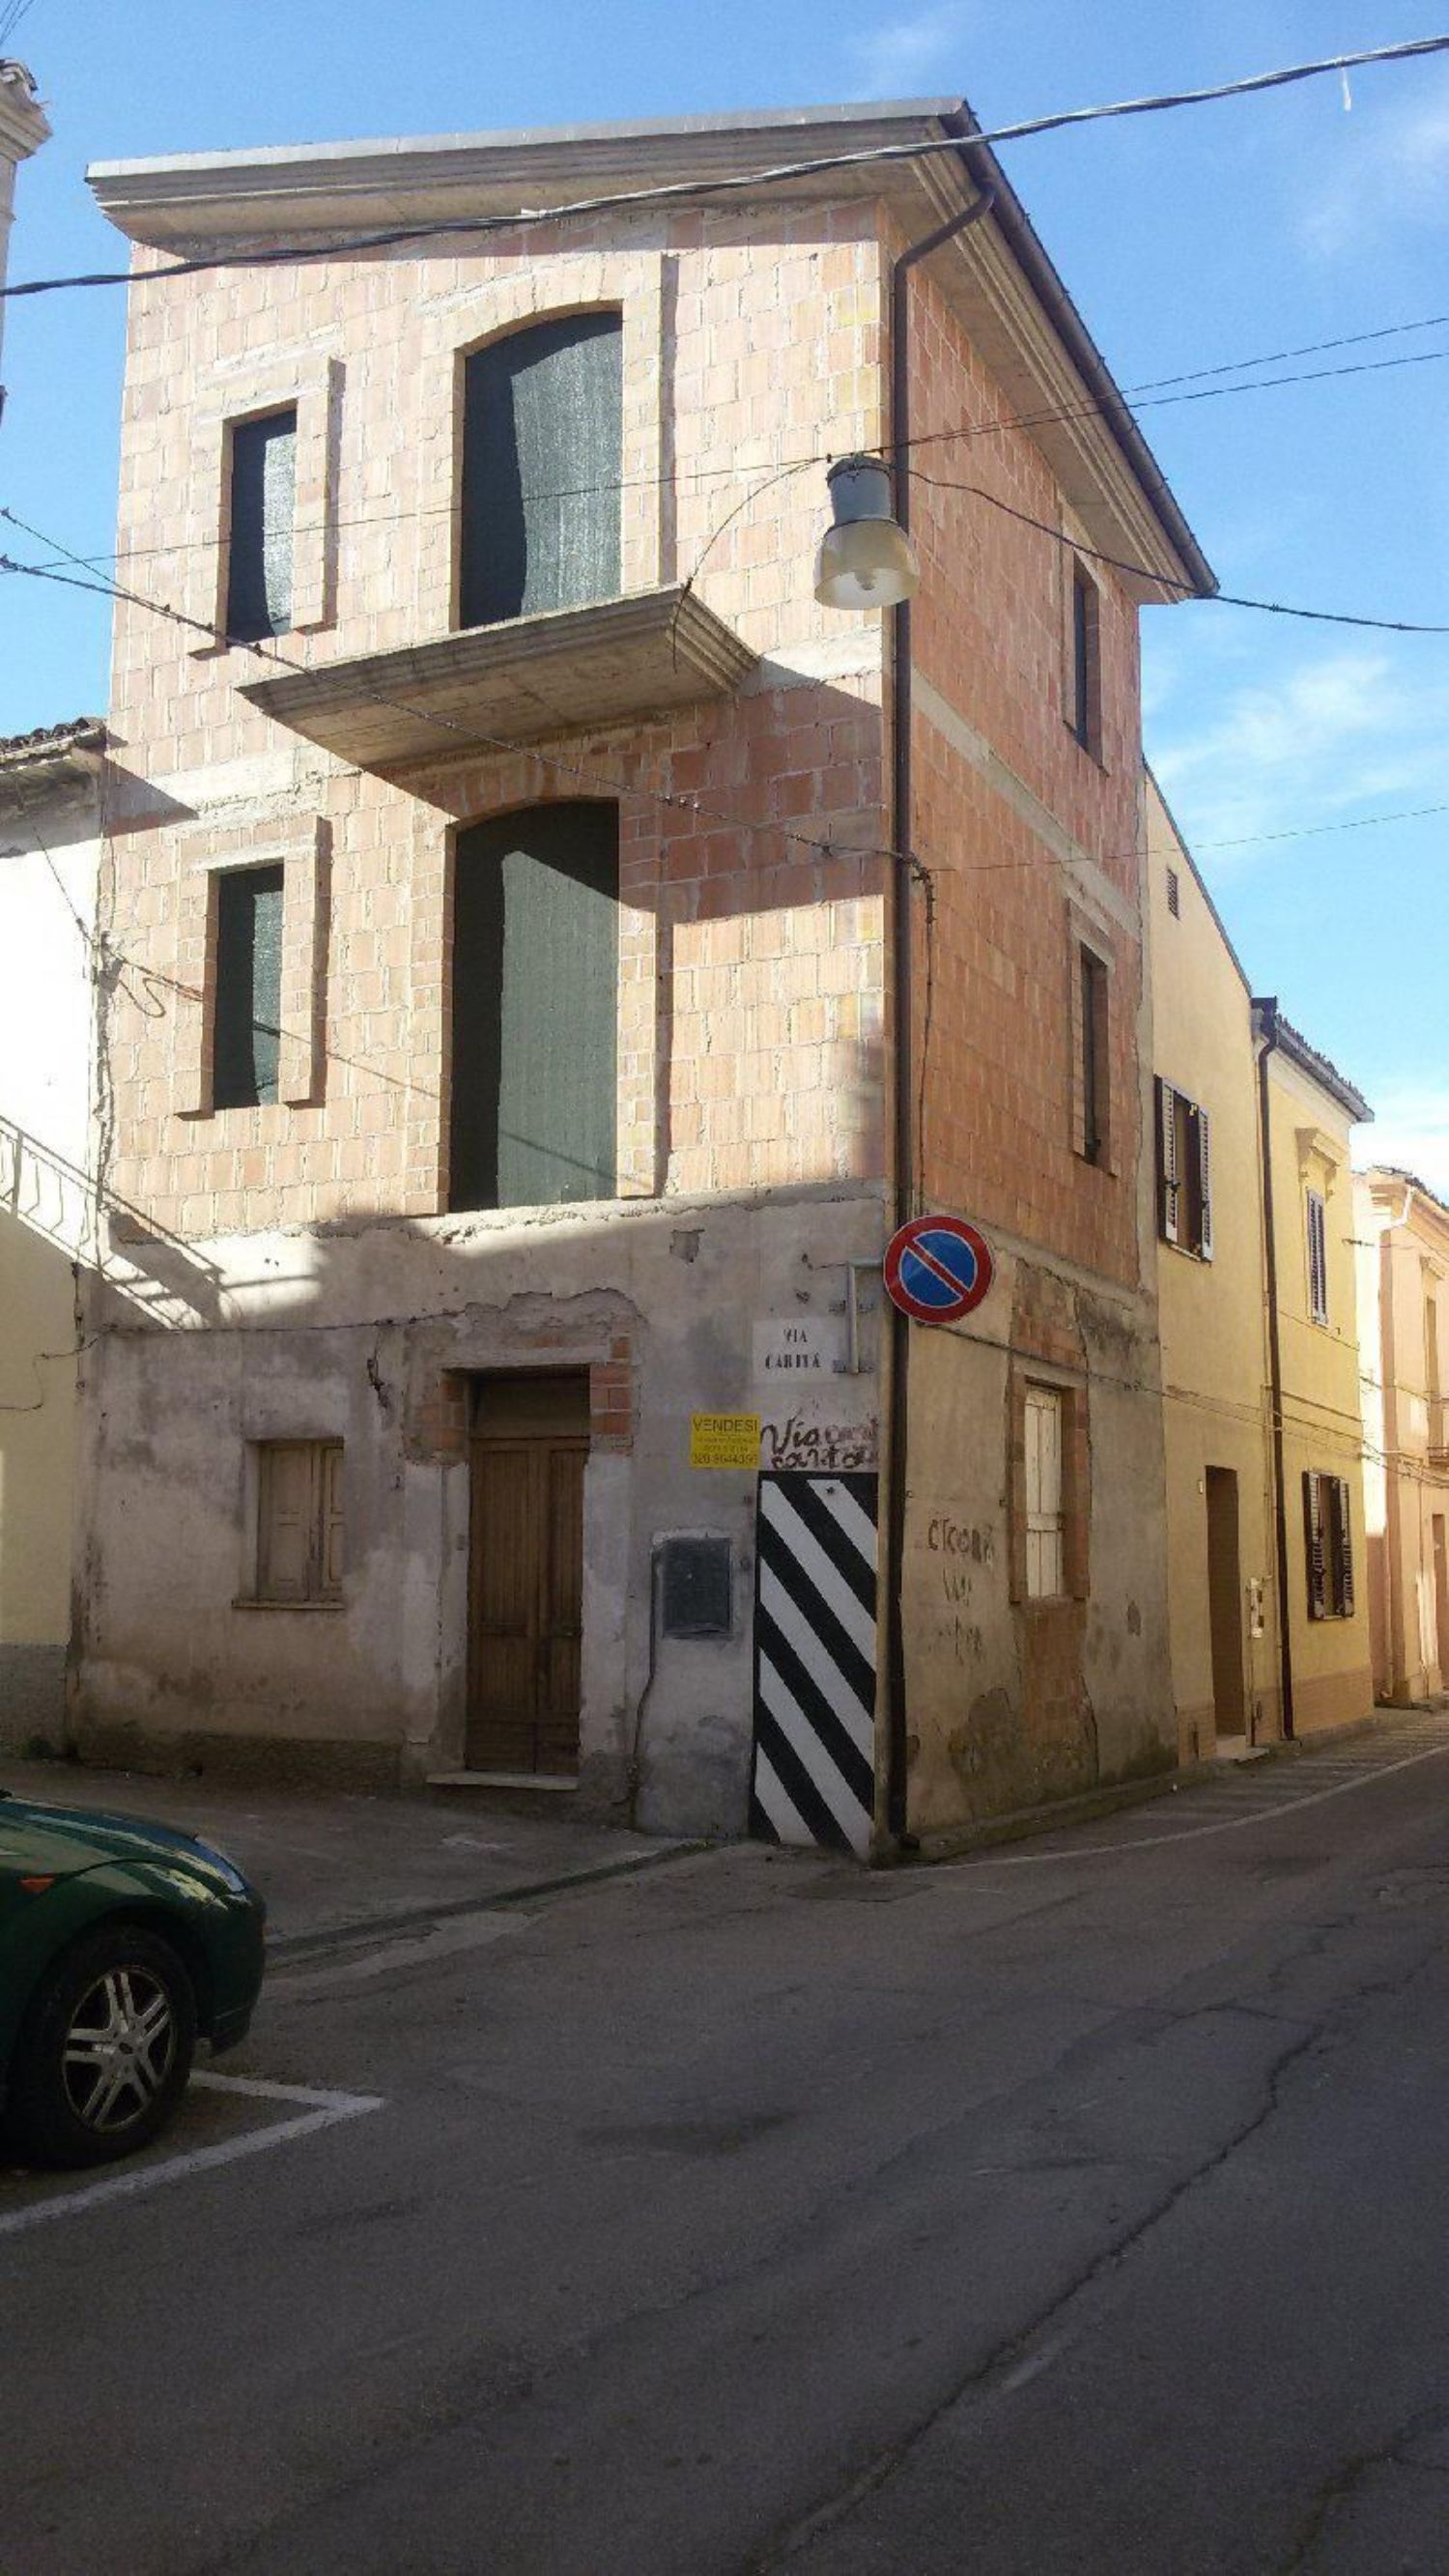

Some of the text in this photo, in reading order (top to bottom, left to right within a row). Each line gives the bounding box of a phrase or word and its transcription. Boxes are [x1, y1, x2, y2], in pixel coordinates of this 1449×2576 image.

[783, 1329, 808, 1343] VIA
[693, 1417, 758, 1432] VENDESI
[760, 1406, 820, 1455] Via
